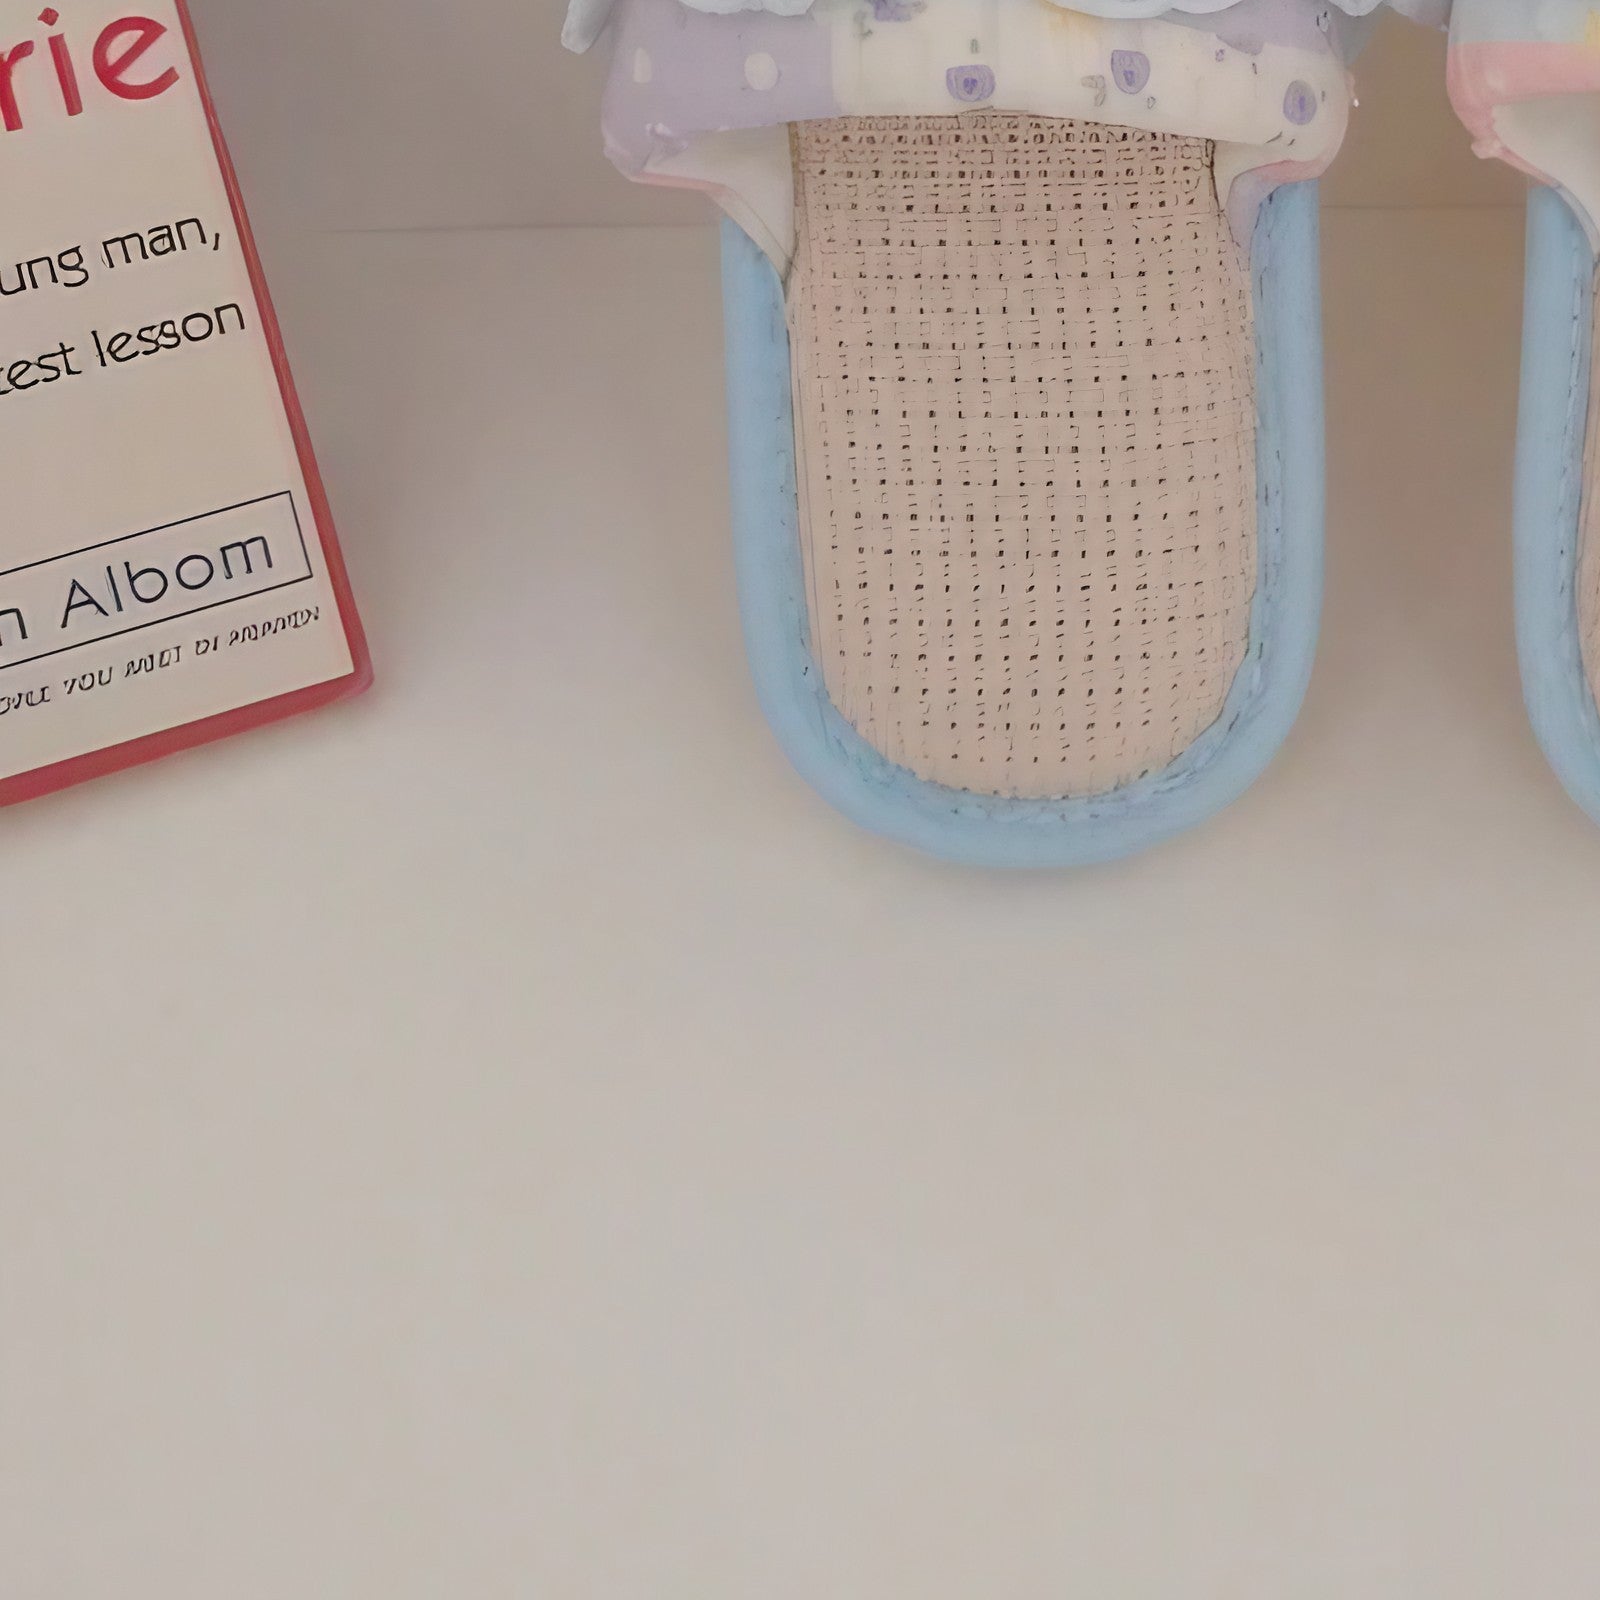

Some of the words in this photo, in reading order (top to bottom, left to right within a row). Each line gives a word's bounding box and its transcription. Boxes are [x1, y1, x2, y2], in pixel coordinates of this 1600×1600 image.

[0, 245, 90, 296] ung
[101, 217, 220, 269] man,
[90, 302, 246, 368] lesson
[60, 535, 274, 630] Albom
